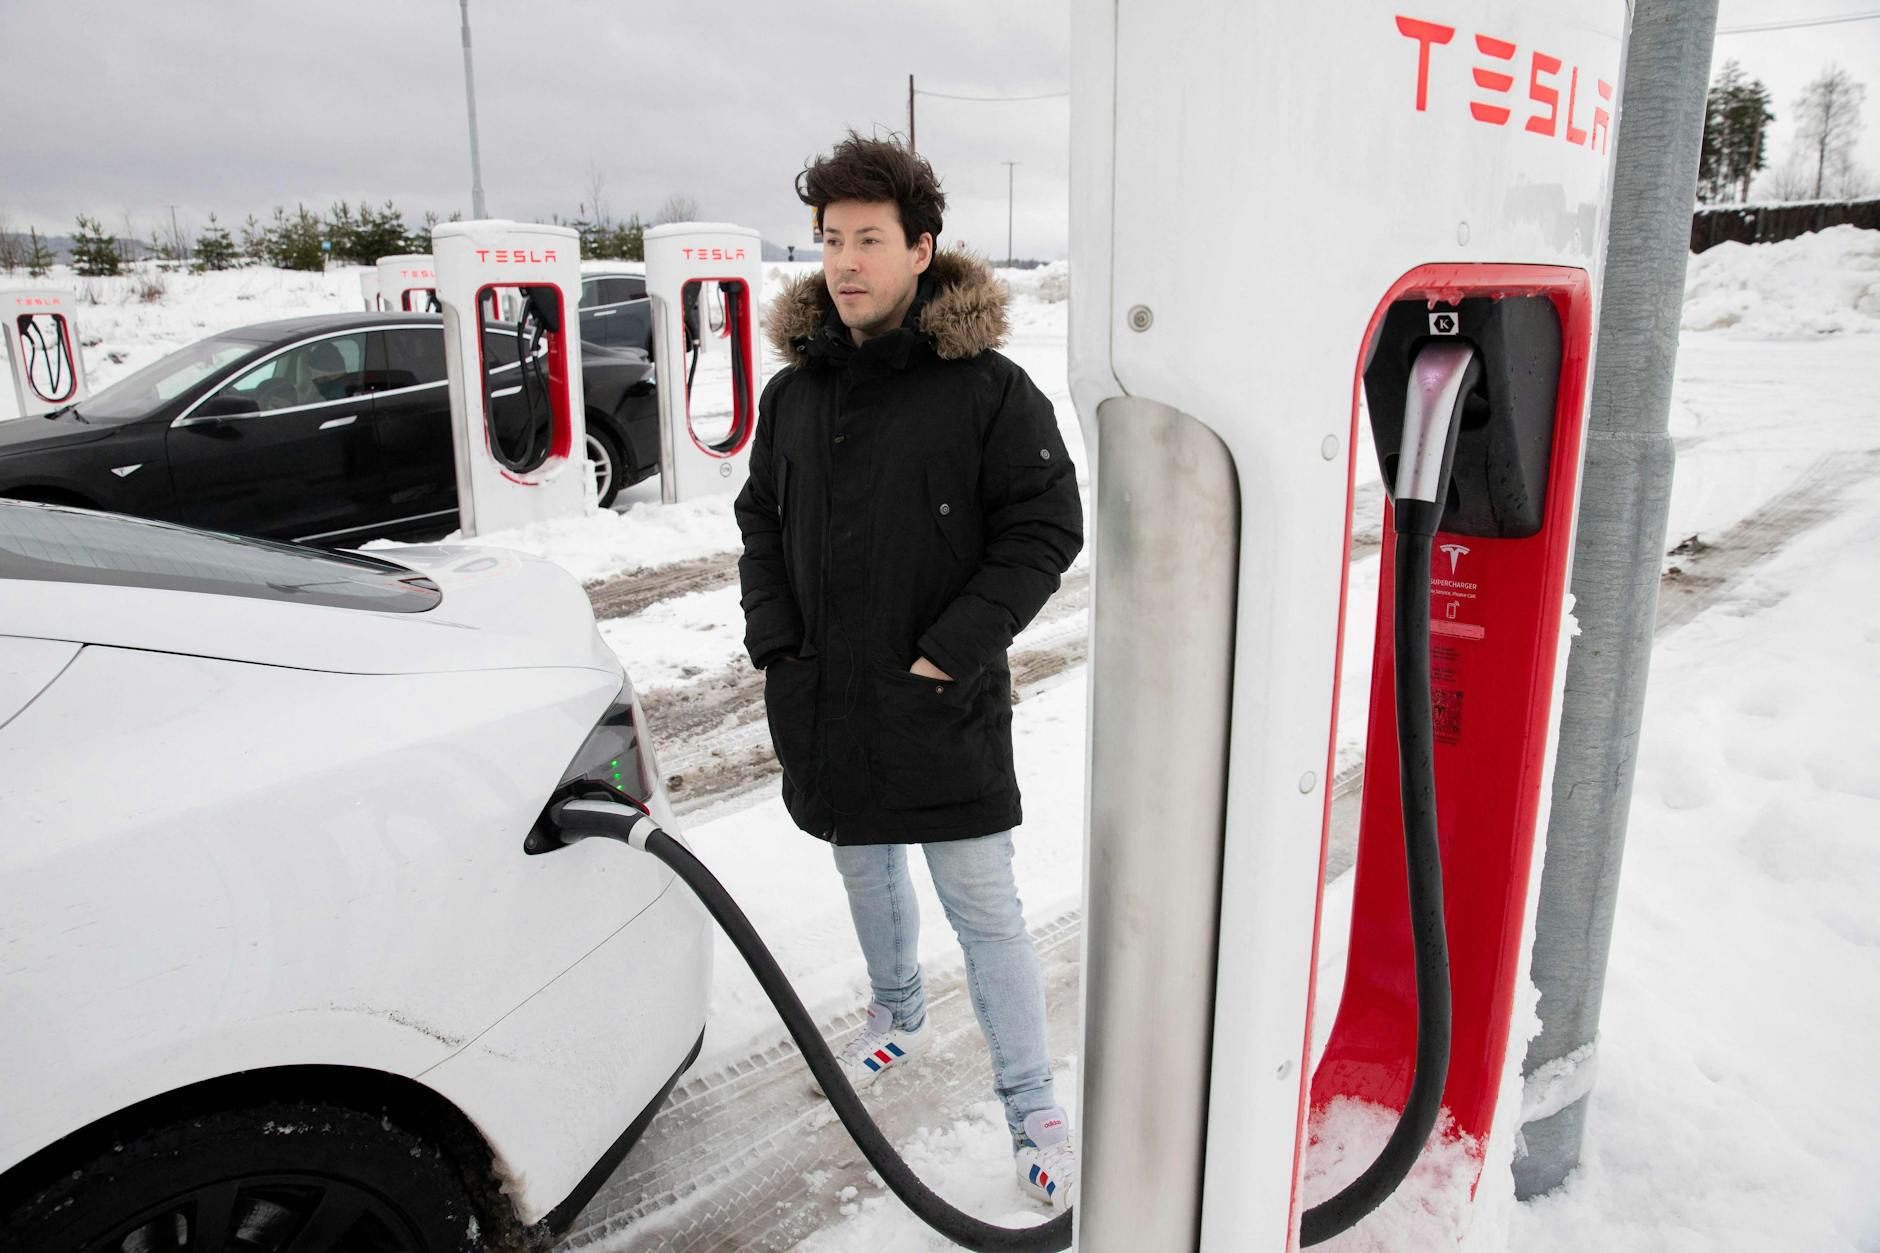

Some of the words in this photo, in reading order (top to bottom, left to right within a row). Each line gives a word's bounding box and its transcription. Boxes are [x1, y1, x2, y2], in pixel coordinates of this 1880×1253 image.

[1395, 15, 1612, 156] TESLA
[475, 250, 556, 263] TESLA
[682, 248, 745, 260] TESLA
[401, 270, 435, 278] TESL
[1439, 318, 1450, 329] K
[1430, 578, 1477, 590] SUPERCHARGER
[1044, 1120, 1062, 1129] adidas
